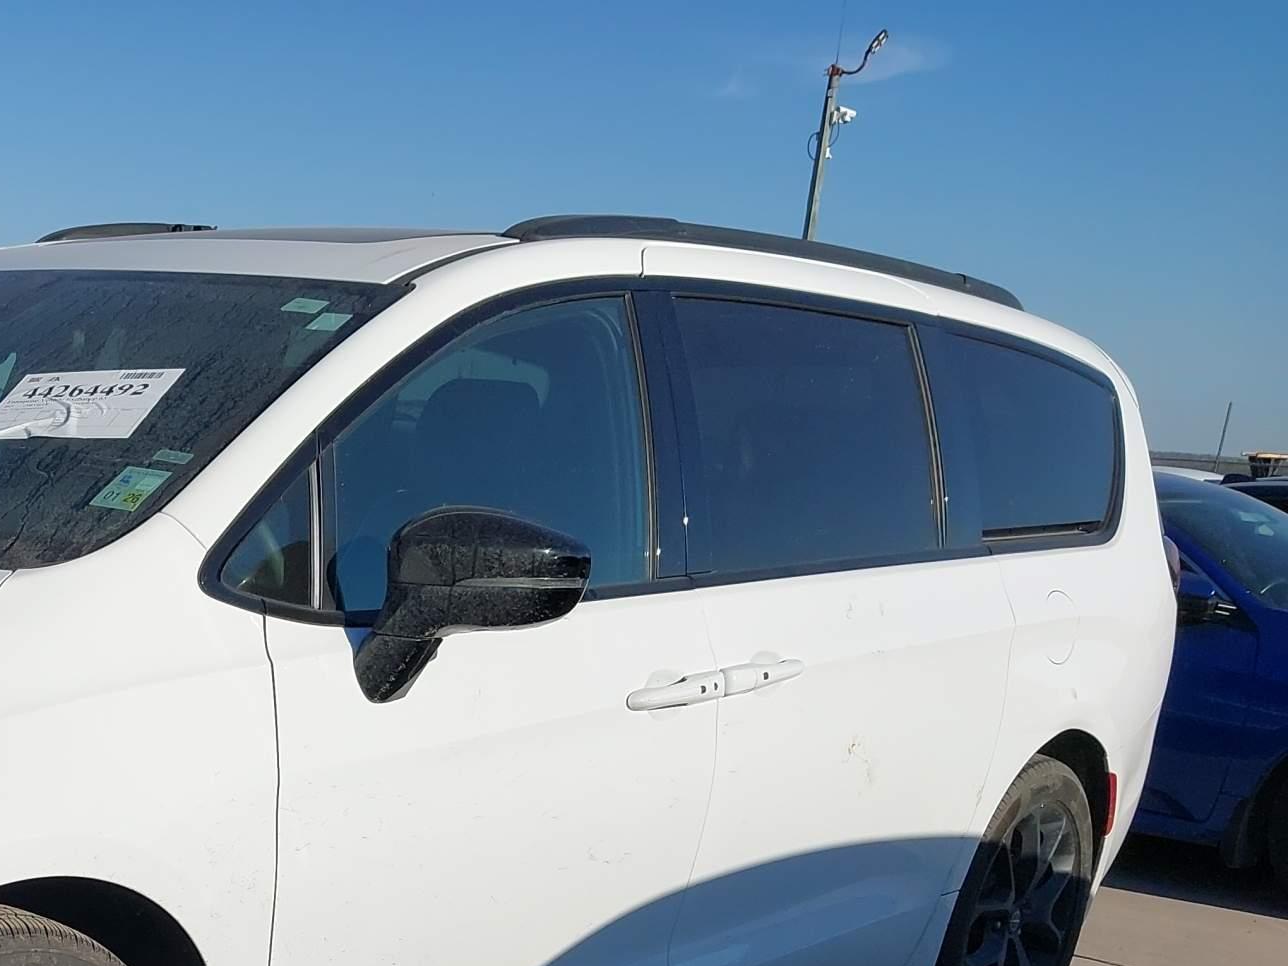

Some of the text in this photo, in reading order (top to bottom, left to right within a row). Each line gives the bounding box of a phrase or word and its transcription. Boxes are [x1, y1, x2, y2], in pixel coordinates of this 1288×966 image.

[23, 383, 150, 399] 44264492
[103, 491, 143, 504] 01 26
